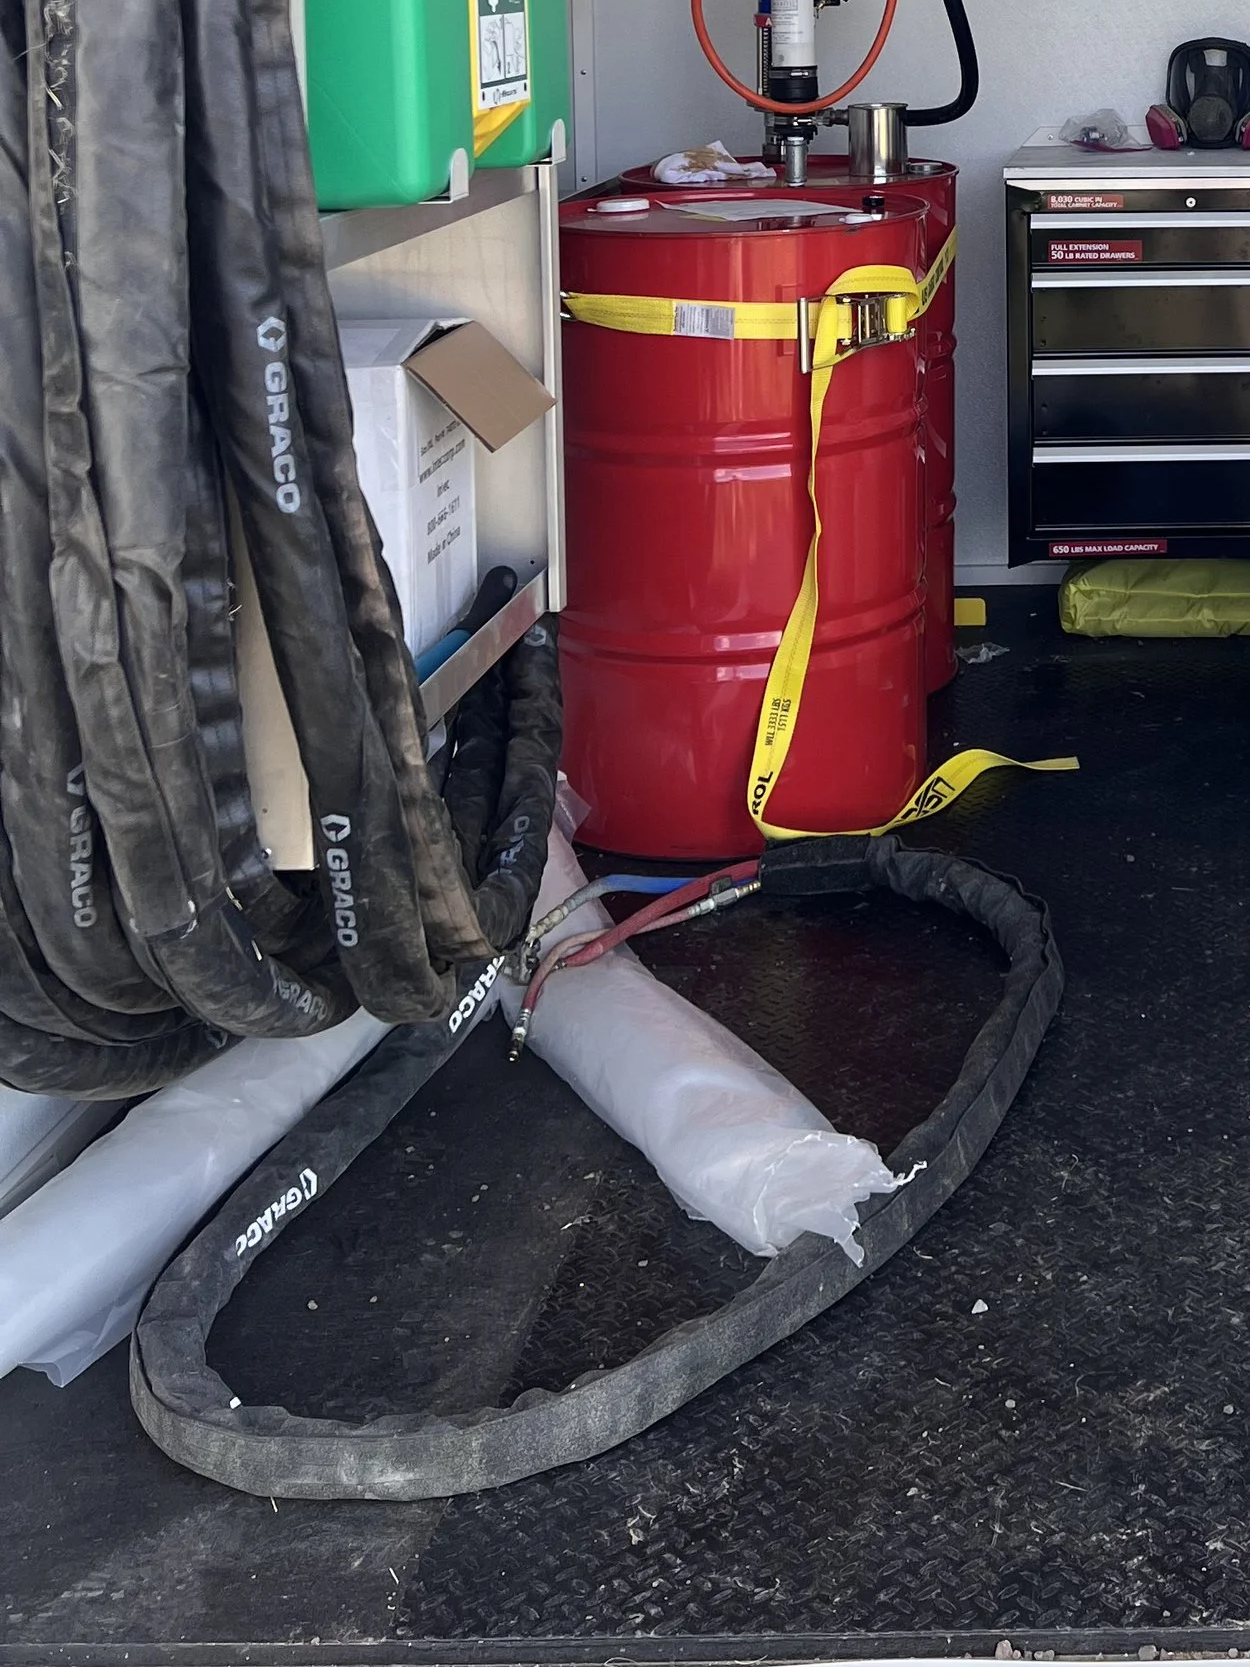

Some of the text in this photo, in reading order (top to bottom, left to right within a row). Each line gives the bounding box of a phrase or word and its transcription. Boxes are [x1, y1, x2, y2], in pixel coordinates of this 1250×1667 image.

[1051, 243, 1109, 251] FULL EXTENSION
[1051, 251, 1064, 260] 50
[1100, 251, 1136, 259] DRAWERS
[264, 361, 301, 514] GRACO
[1052, 545, 1070, 554] 650
[1085, 545, 1103, 553] MAX
[1103, 544, 1124, 552] LOAD
[1124, 543, 1159, 551] CAPACITY
[69, 805, 98, 929] GRACO
[326, 847, 359, 949] GRACO
[235, 1186, 303, 1257] GRACO
